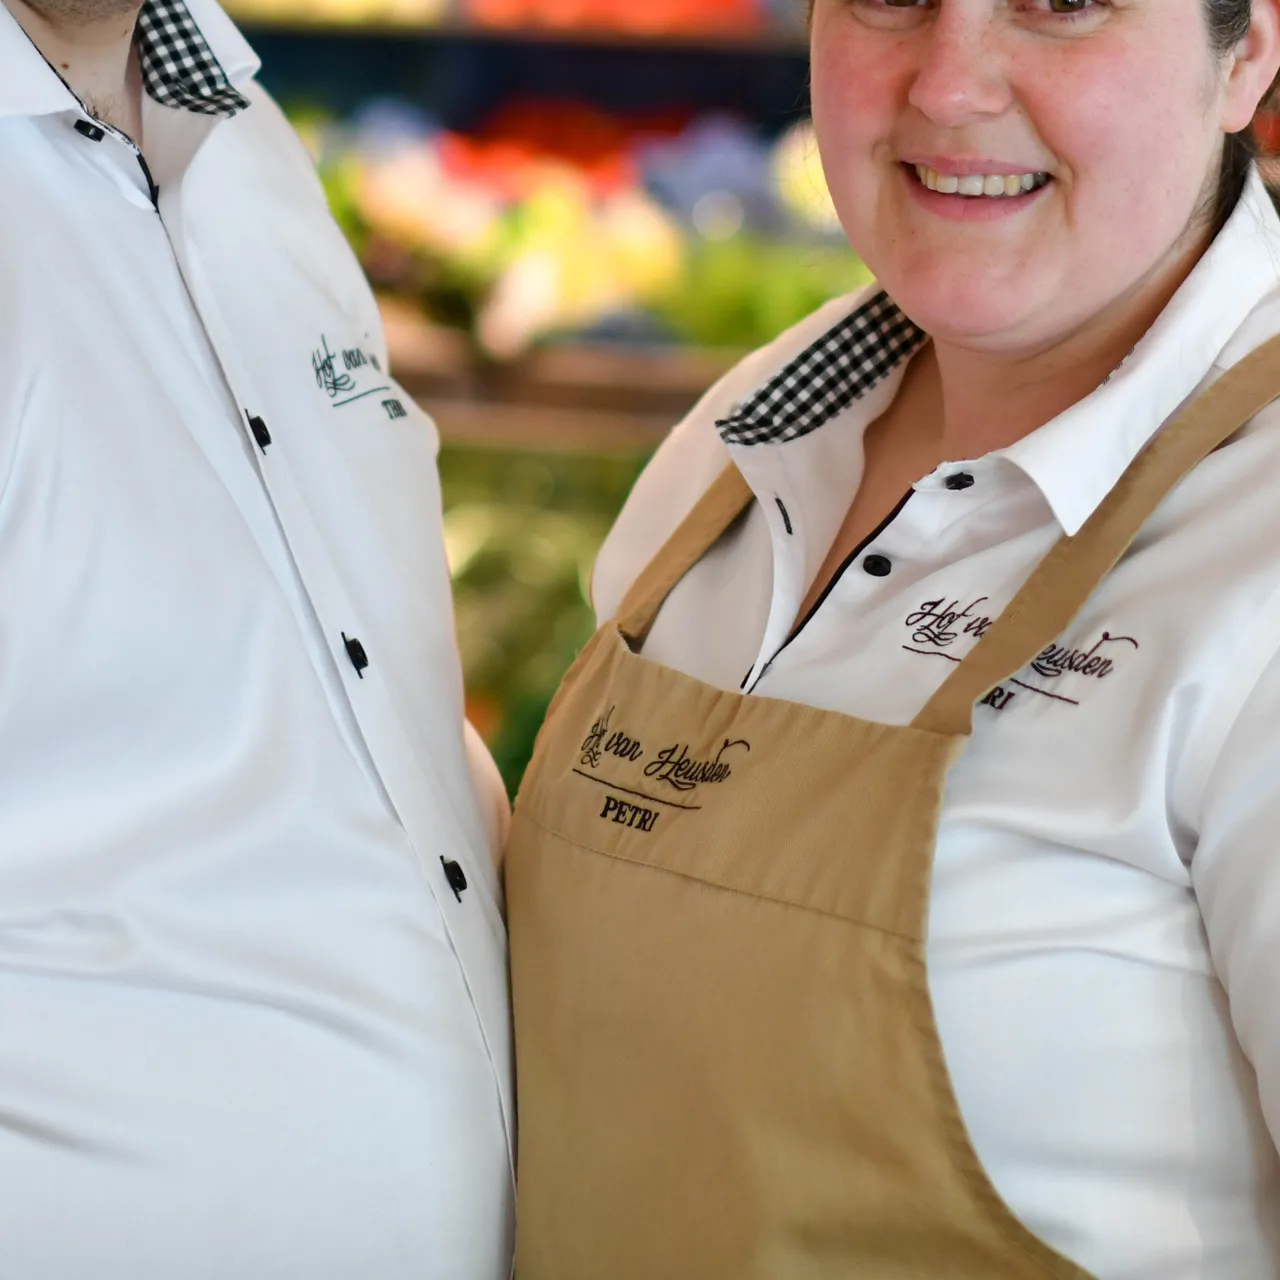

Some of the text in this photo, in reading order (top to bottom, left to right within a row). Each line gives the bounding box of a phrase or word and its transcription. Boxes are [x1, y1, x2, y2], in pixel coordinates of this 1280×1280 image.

[905, 597, 988, 646] Hof
[1031, 631, 1138, 677] eusden
[604, 731, 644, 762] van
[644, 738, 750, 791] Heusden
[599, 795, 659, 832] PETRI
